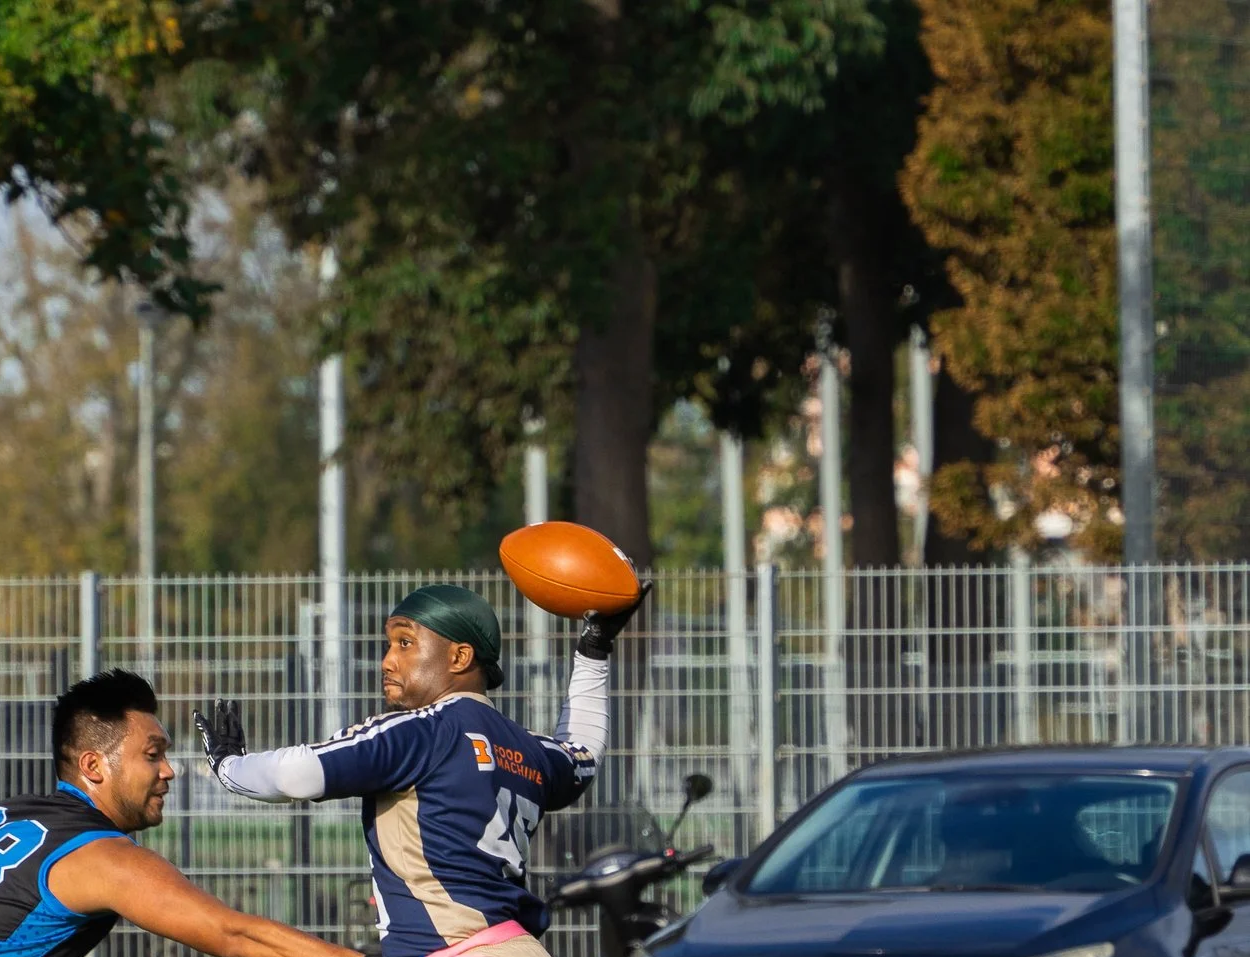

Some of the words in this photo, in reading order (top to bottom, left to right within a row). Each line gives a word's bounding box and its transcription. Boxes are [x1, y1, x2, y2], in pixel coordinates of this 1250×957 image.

[493, 744, 524, 764] FOOD
[495, 757, 543, 785] MACHINE
[476, 786, 540, 880] 45
